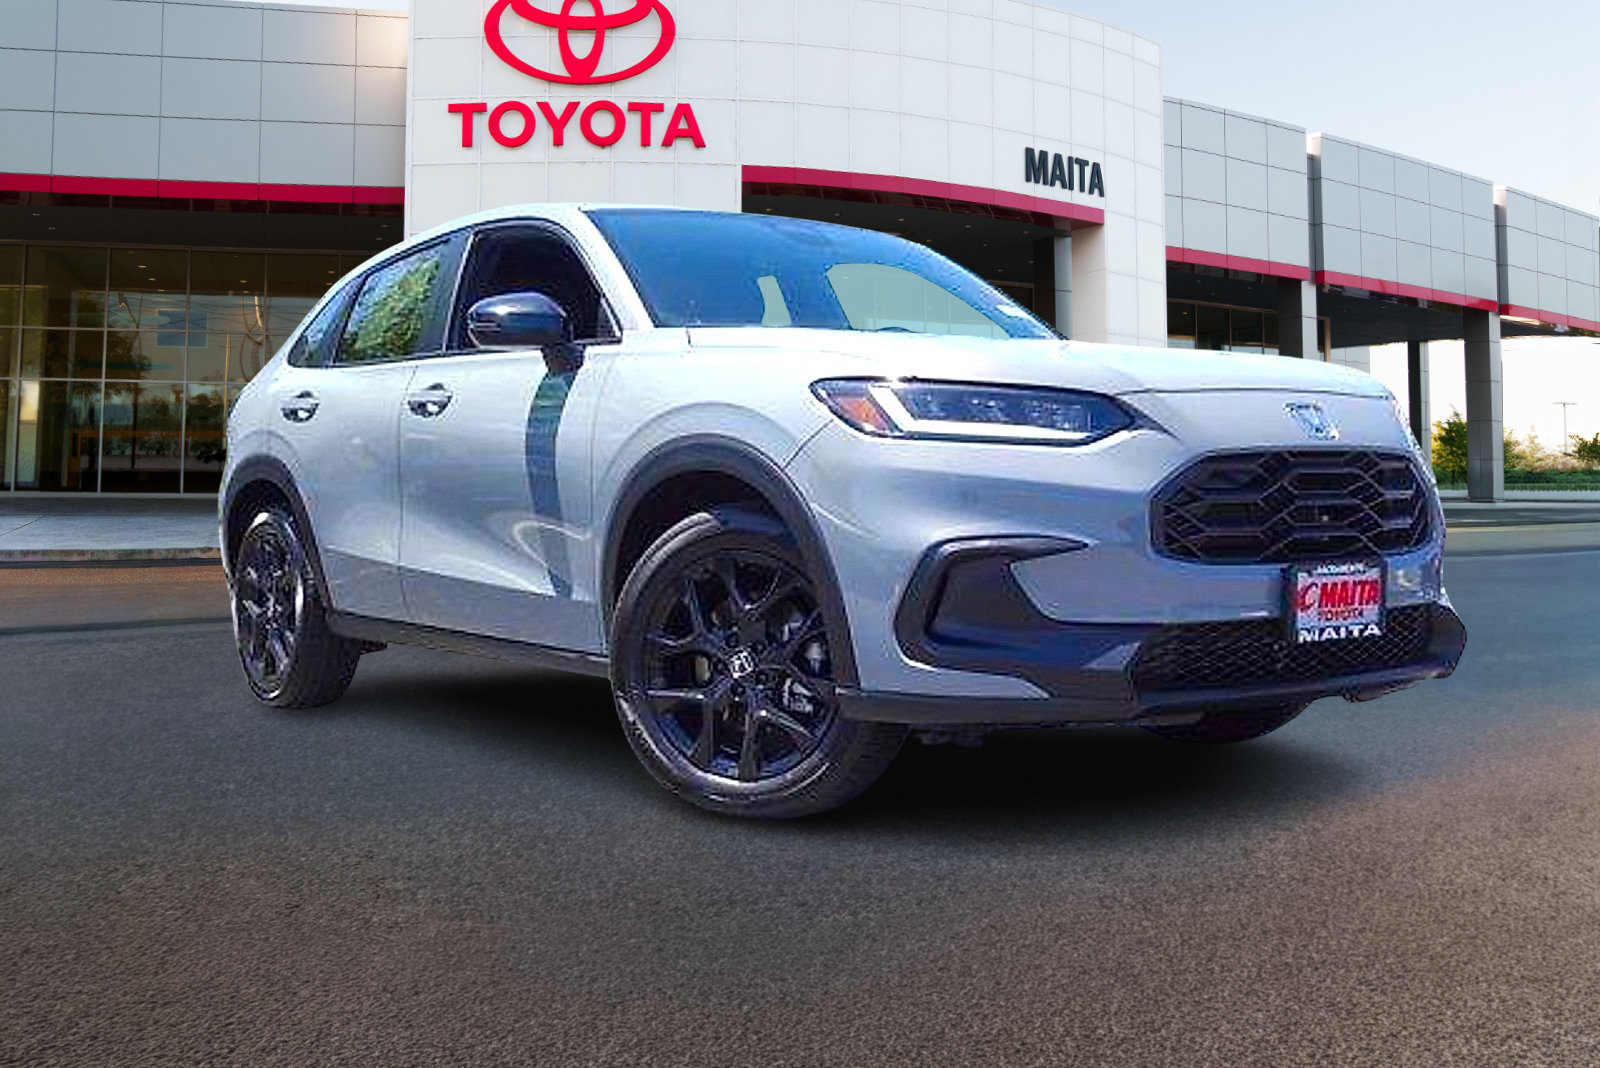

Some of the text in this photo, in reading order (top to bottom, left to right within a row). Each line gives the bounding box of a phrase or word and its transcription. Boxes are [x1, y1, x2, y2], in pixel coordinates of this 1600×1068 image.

[448, 100, 706, 148] TOYOTA
[1025, 147, 1105, 198] MAITA
[1318, 580, 1380, 609] MAITA
[1298, 624, 1382, 643] MAITA
